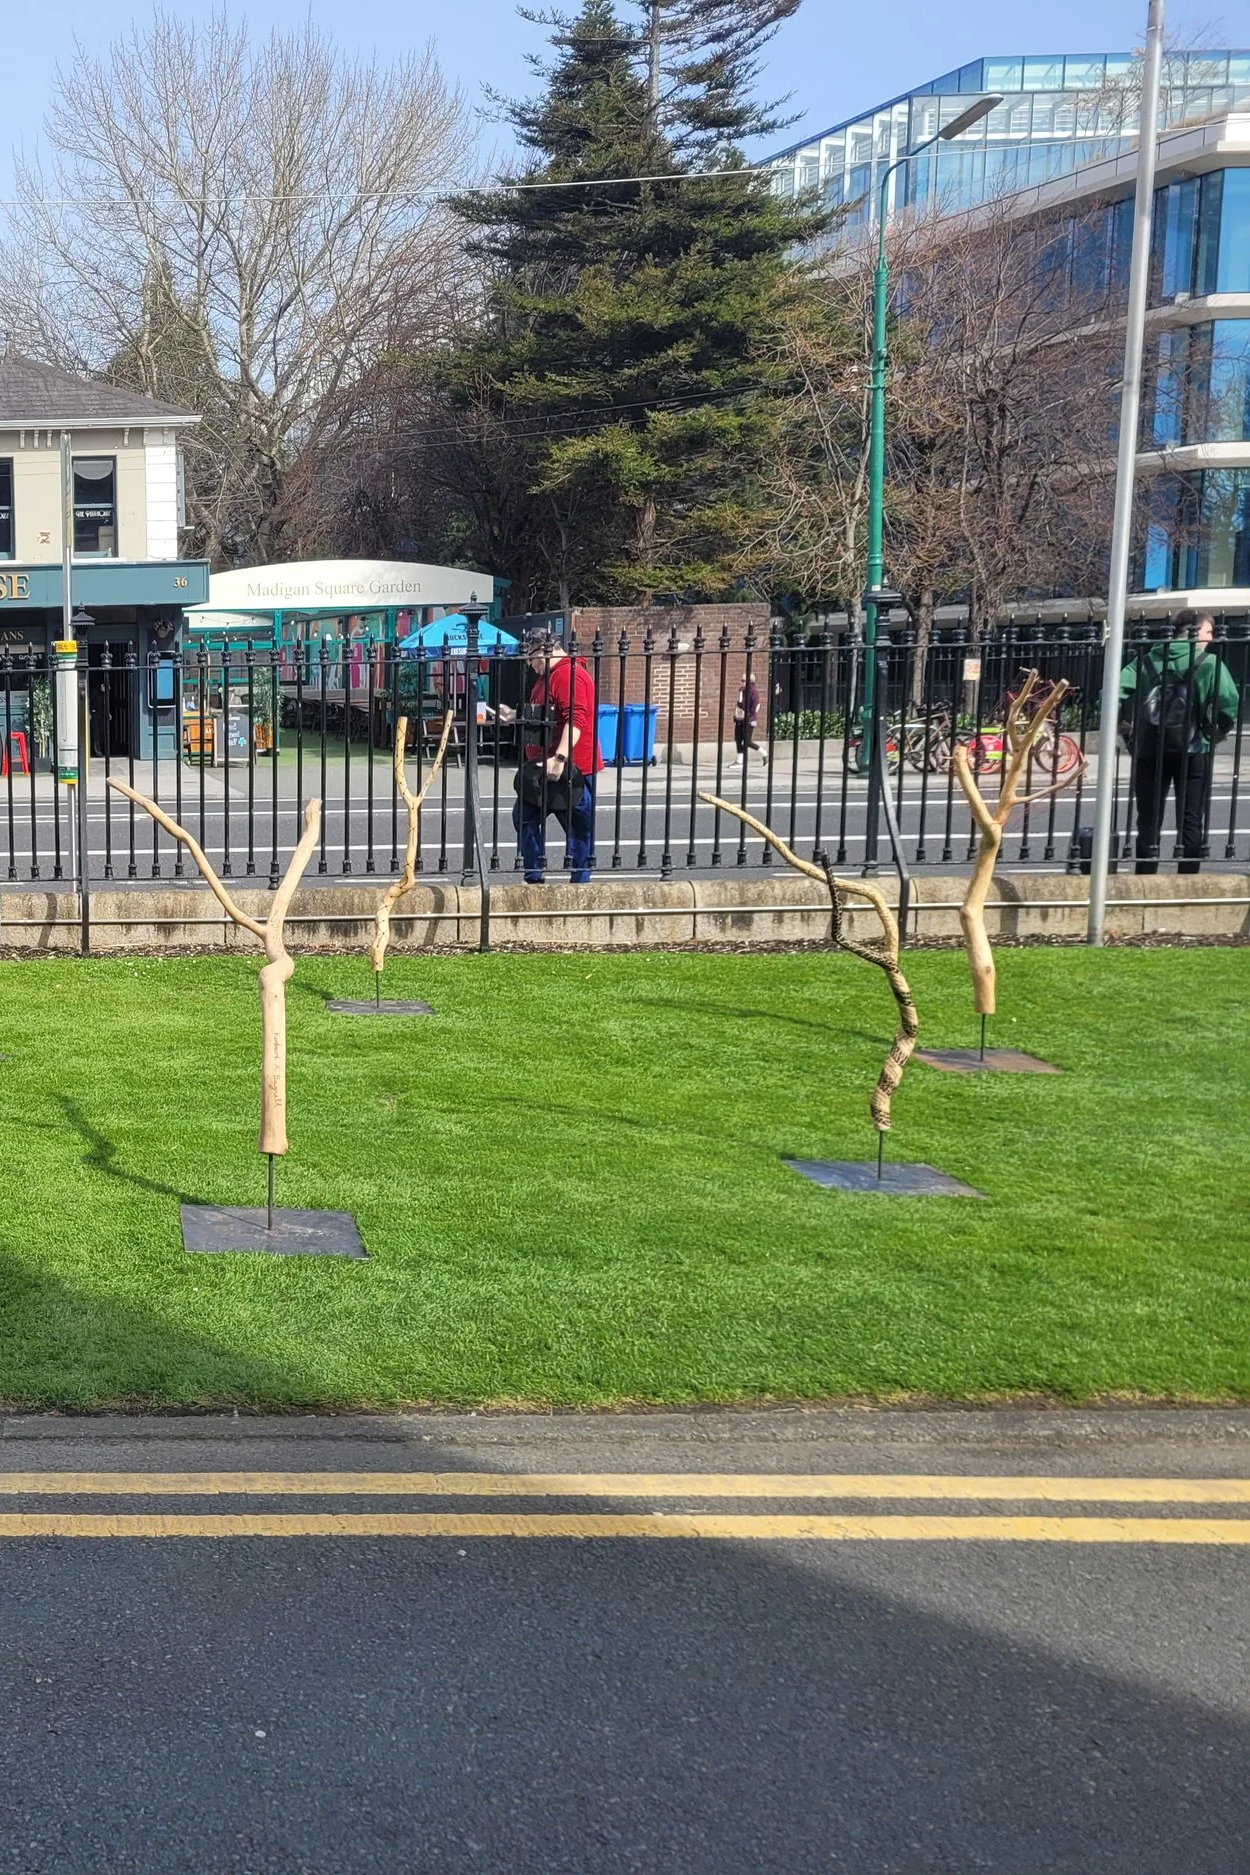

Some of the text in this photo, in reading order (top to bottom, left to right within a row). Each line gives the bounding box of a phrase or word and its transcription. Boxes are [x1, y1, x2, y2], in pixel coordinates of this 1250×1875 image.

[173, 577, 187, 588] 36
[247, 579, 421, 599] Madigan Square Garden
